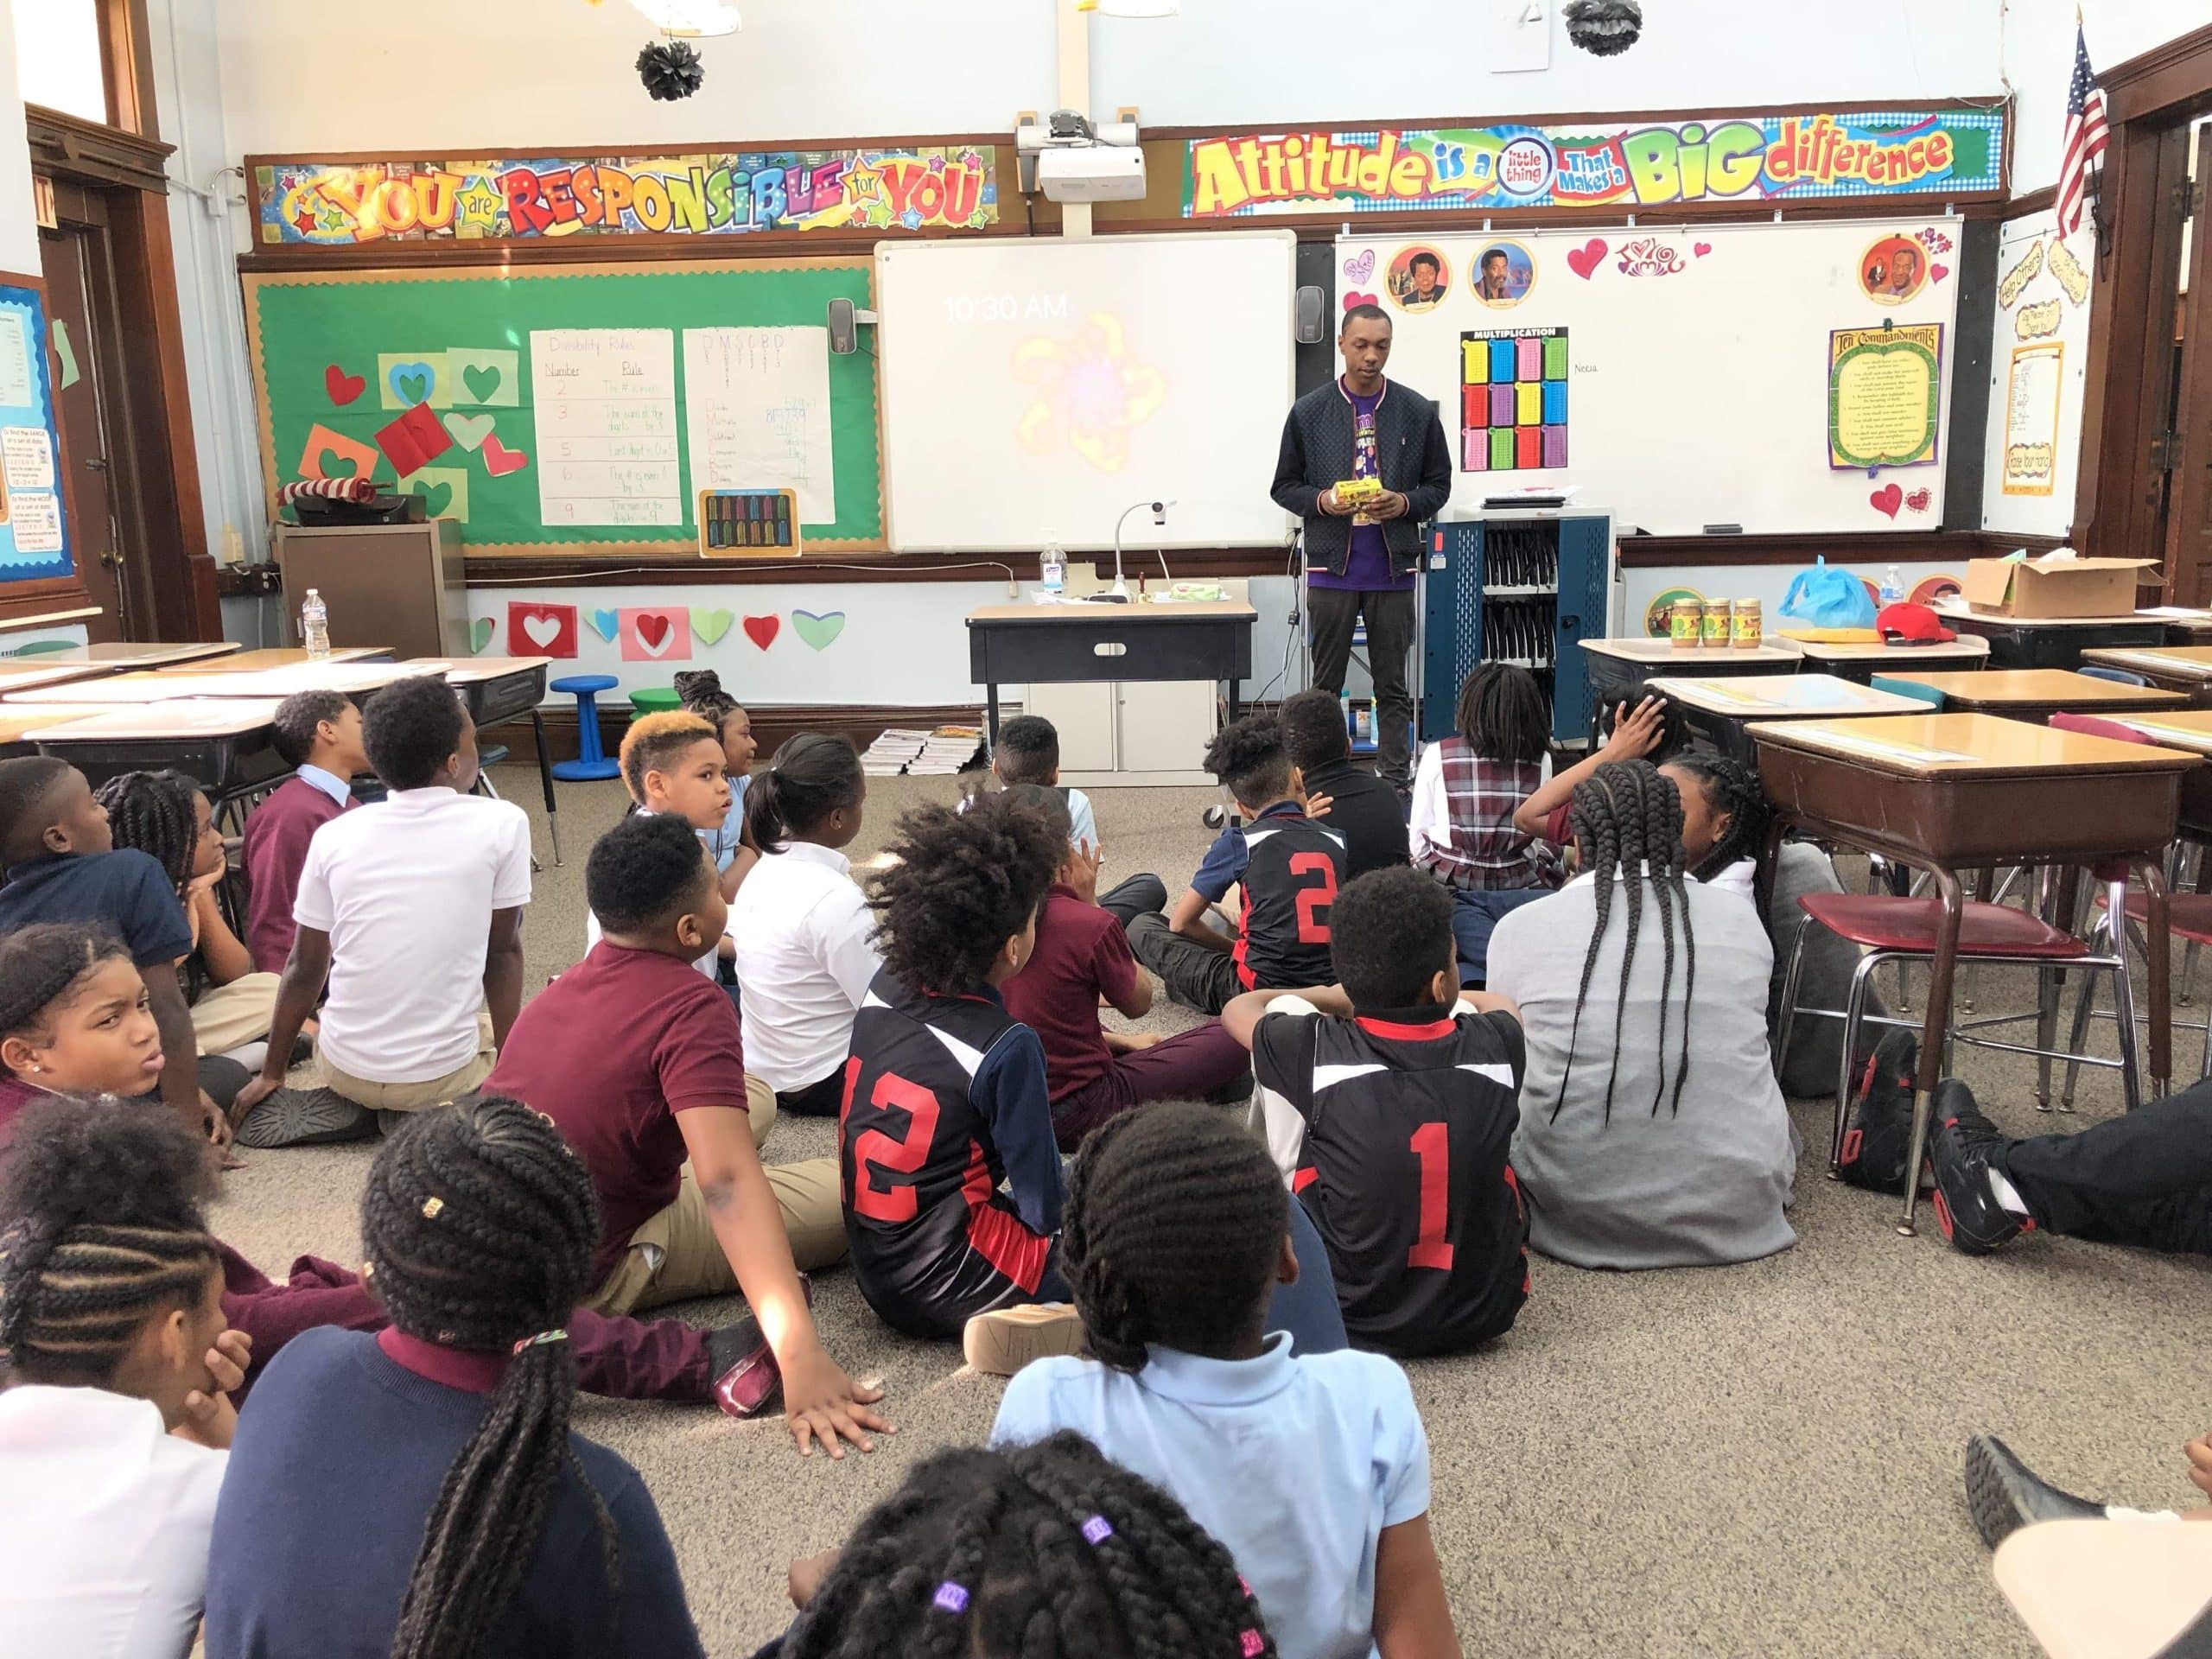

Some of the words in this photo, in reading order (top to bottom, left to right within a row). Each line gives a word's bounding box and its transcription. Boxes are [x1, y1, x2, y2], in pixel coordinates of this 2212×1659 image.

[1509, 151, 1541, 168] little
[1566, 148, 1612, 174] That
[1767, 117, 1951, 184] difference
[1192, 130, 1430, 215] Attitude
[1433, 143, 1465, 180] is
[1474, 150, 1494, 179] a
[1506, 166, 1541, 184] thing
[1558, 170, 1613, 194] Makes
[1613, 168, 1624, 184] a
[469, 195, 493, 215] are
[852, 171, 874, 195] for
[881, 162, 980, 224] YOU
[2016, 252, 2040, 285] Others
[1024, 293, 1069, 319] AM
[1473, 327, 1556, 339] MULTIPLICATION
[1835, 332, 1855, 356] Ten
[1858, 327, 1936, 347] Commandments
[545, 361, 581, 376] Number
[1288, 852, 1338, 943] 2
[1408, 1122, 1454, 1271] 1
